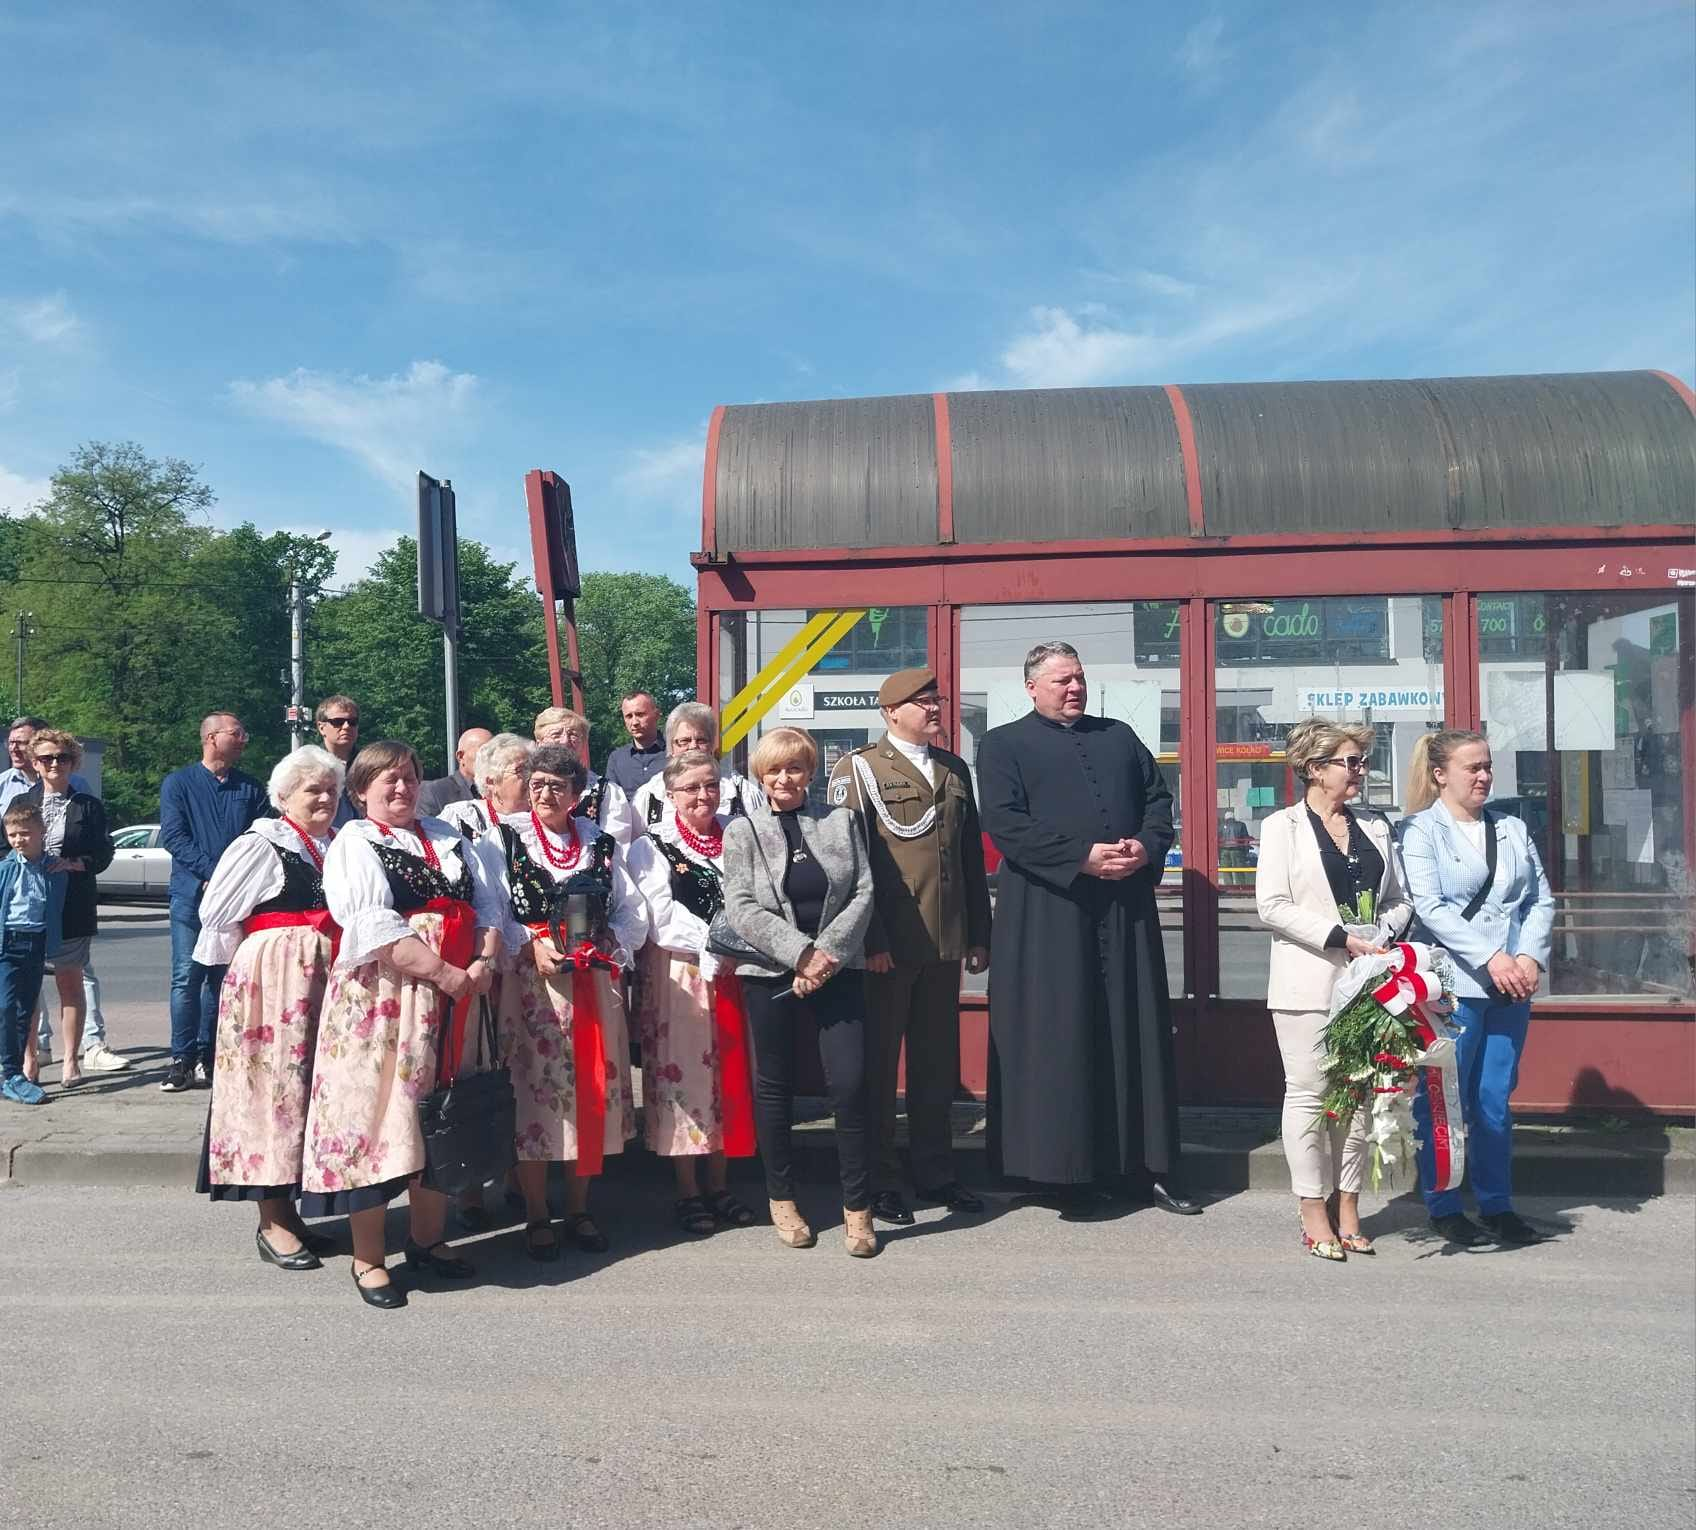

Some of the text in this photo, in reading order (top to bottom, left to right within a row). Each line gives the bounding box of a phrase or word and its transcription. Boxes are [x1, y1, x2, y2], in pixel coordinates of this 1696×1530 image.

[1481, 618, 1506, 633] 700
[823, 696, 866, 707] SZKOŁA
[1307, 692, 1354, 707] SKLEP
